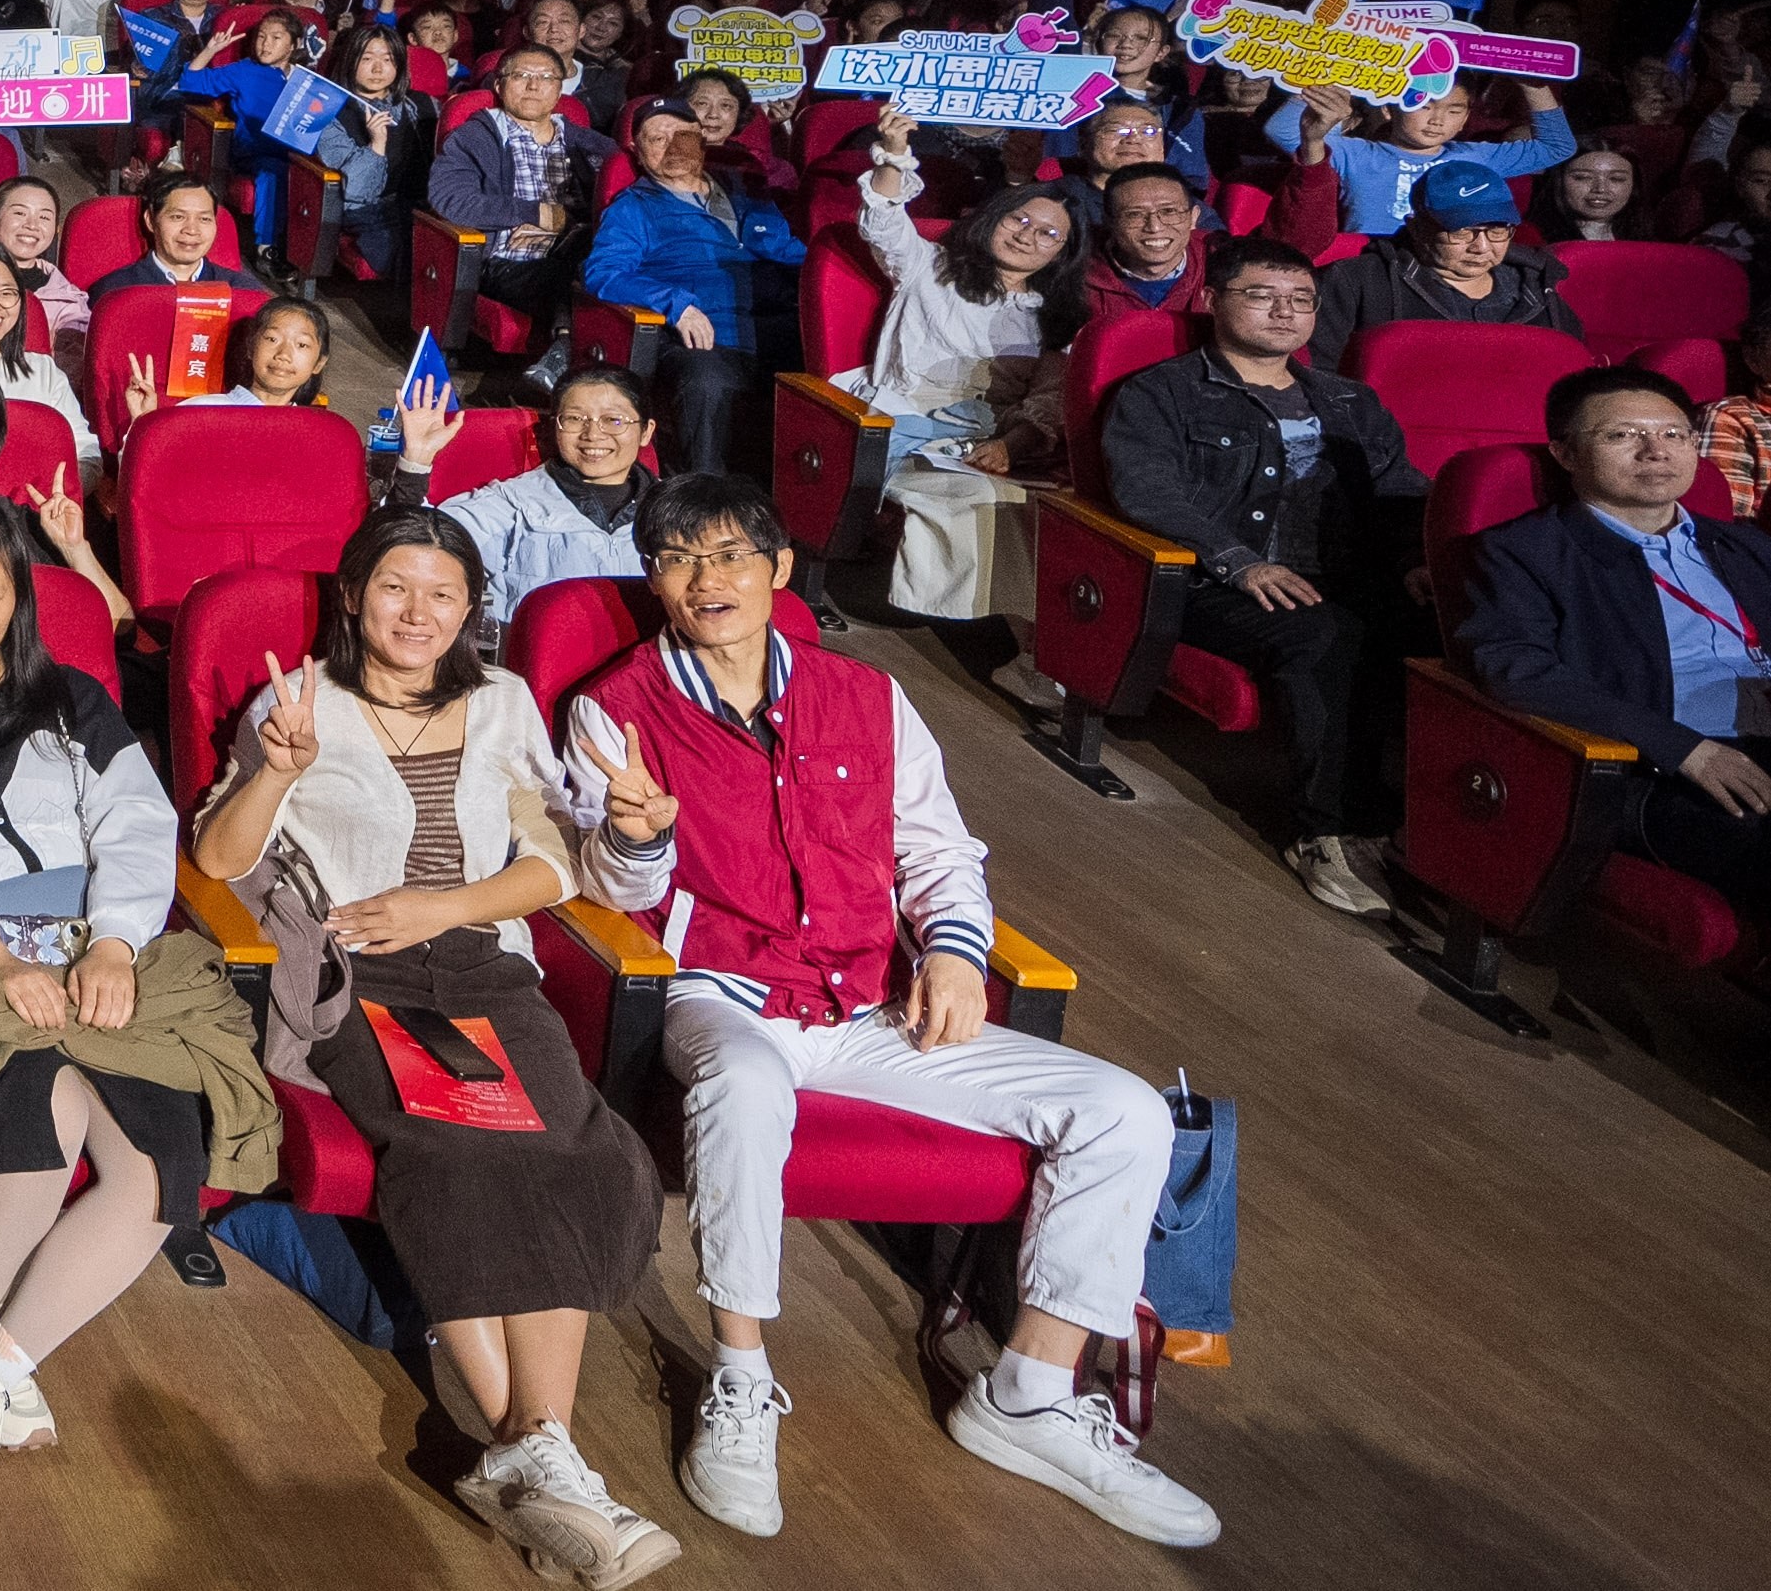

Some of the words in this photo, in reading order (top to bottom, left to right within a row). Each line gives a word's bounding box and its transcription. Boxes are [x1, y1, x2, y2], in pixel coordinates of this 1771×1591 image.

[900, 33, 993, 52] SJTUME
[1345, 10, 1414, 42] SJTUME
[133, 41, 155, 57] ME
[840, 50, 1045, 93] 饮水思源
[901, 90, 1066, 125] 爱国荣校
[186, 333, 210, 379] 嘉宾
